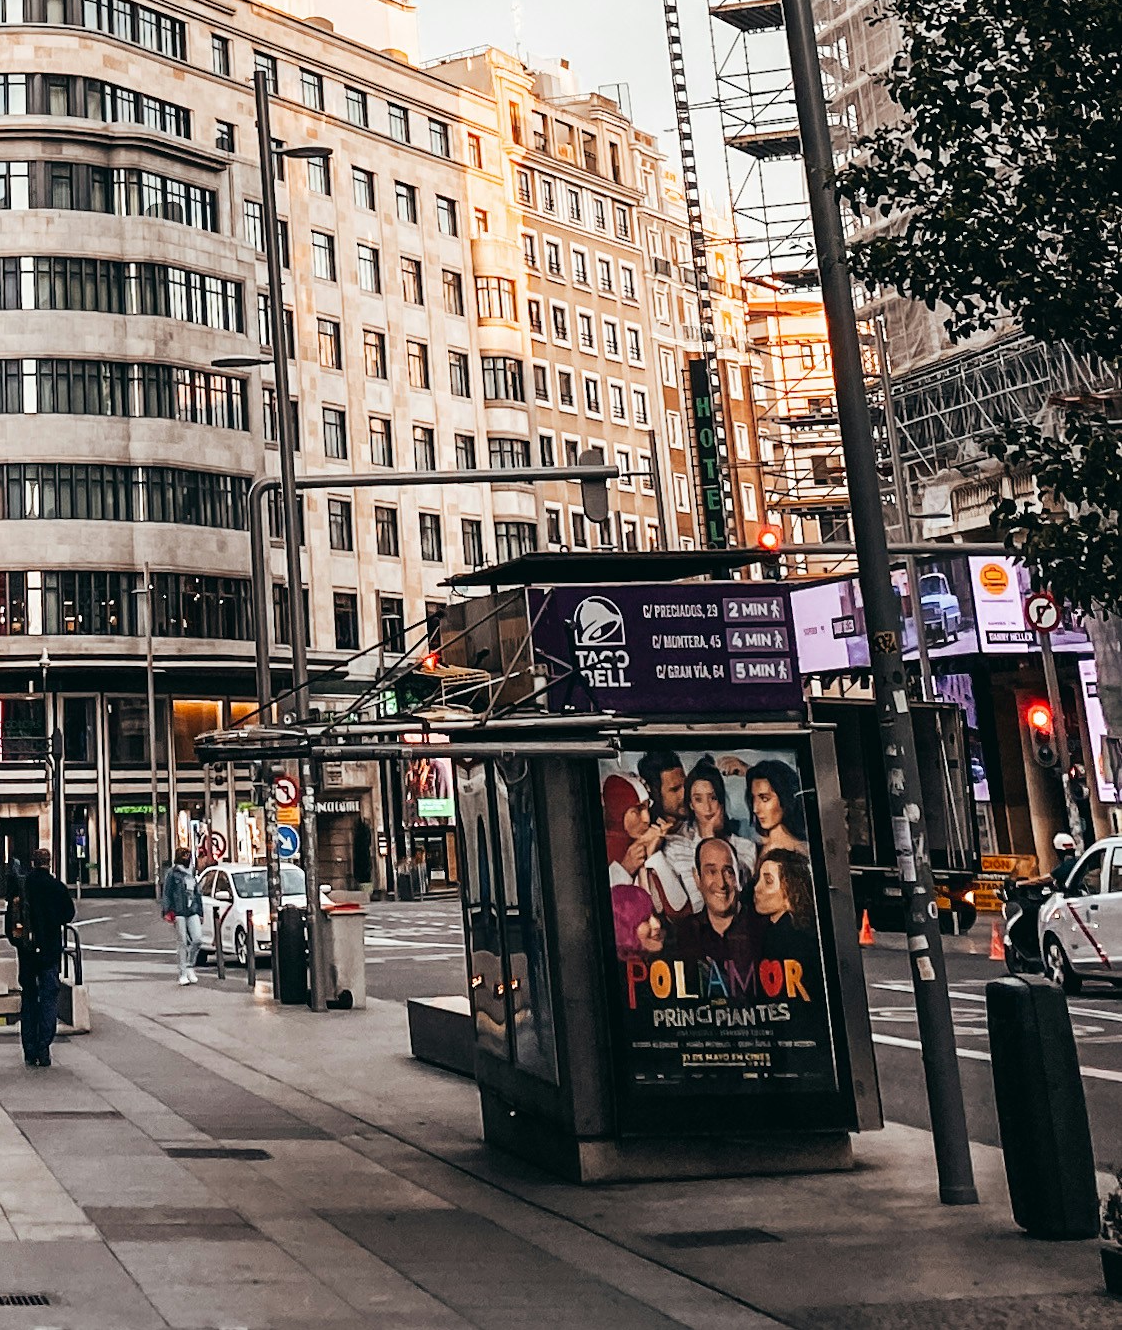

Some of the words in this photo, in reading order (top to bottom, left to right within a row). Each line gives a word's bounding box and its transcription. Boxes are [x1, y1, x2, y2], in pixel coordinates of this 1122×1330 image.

[695, 396, 724, 542] HOTEL
[654, 604, 706, 619] PRECIADOS,
[707, 604, 718, 617] 29
[728, 601, 739, 618] 2
[742, 601, 768, 617] MIN
[663, 634, 709, 649] MONTERA,
[710, 634, 722, 648] 45
[731, 631, 743, 648] 4
[745, 633, 773, 647] MIN
[667, 665, 692, 679] GRAN
[712, 664, 725, 678] 64
[735, 663, 746, 679] 5
[748, 663, 776, 678] MIN
[627, 955, 811, 1010] POLIAMOR
